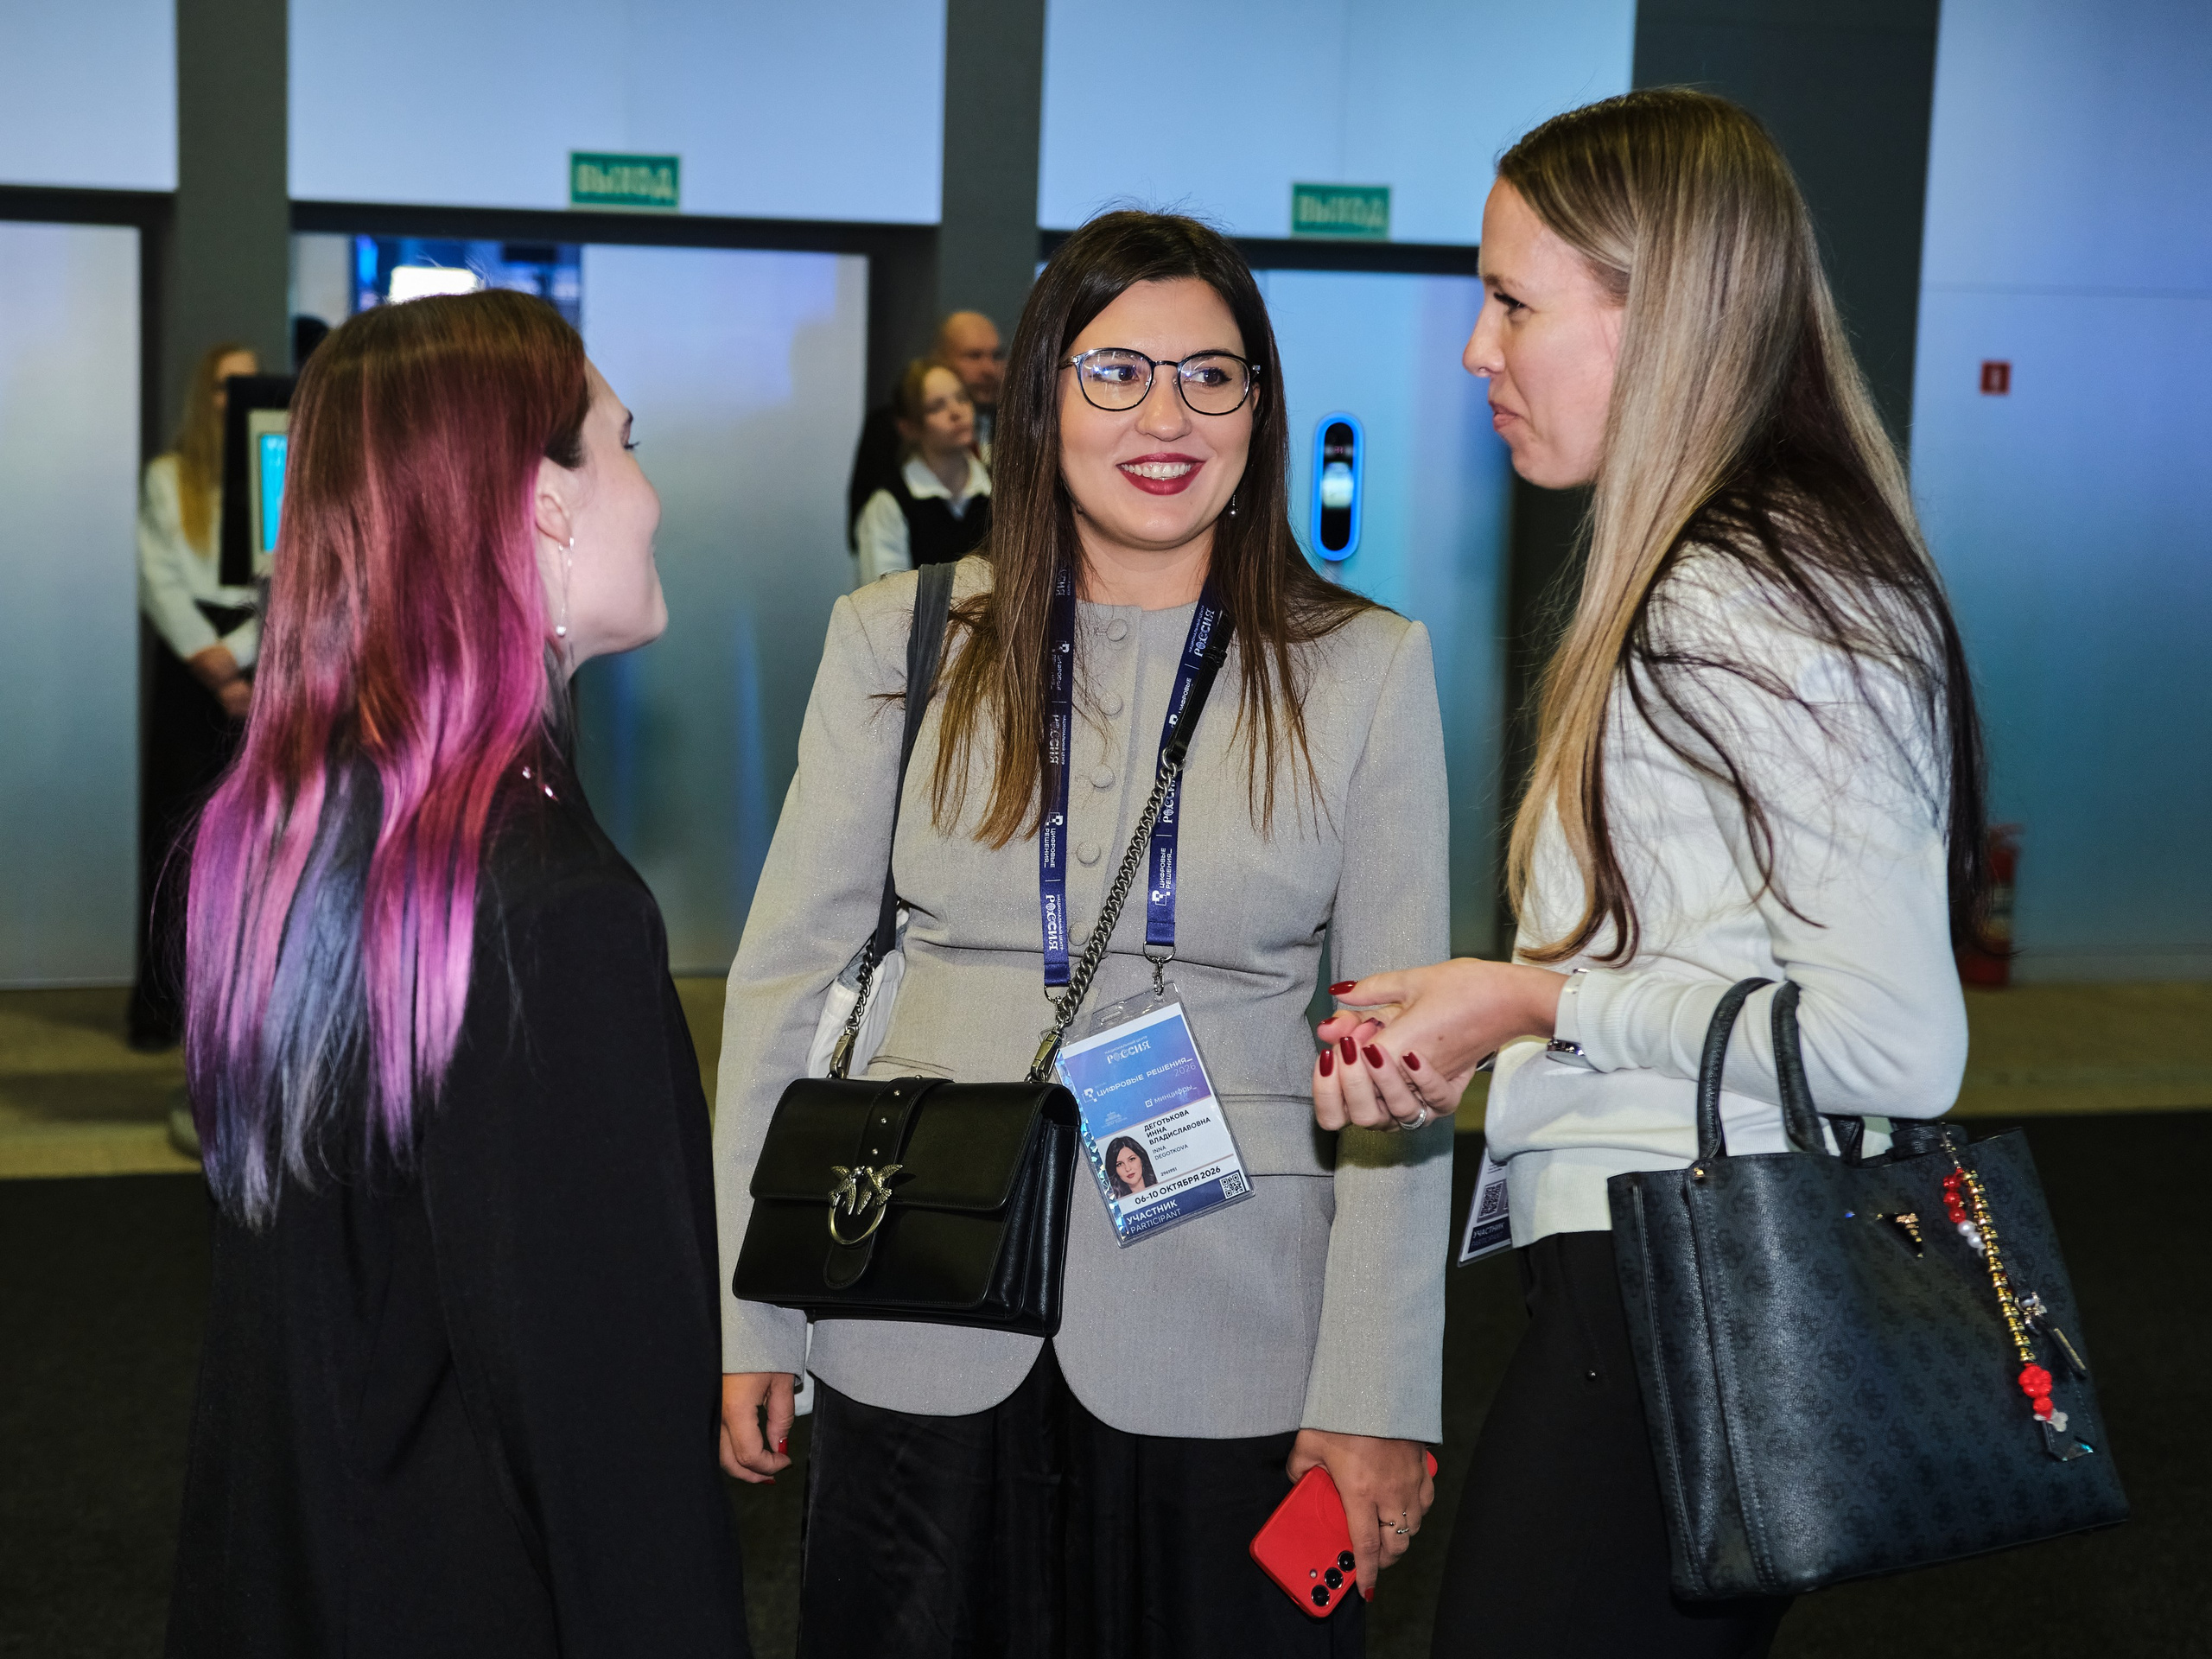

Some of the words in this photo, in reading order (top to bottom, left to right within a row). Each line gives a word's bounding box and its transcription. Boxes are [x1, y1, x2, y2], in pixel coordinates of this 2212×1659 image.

[1194, 607, 1215, 657] РОССИЯ
[1046, 893, 1058, 951] РОССИЯ
[1106, 1040, 1151, 1065] РОССИЯ
[1173, 1063, 1197, 1077] 2026
[1096, 1074, 1144, 1097] ЦИФРОВЫЕ
[1144, 1109, 1190, 1132] ДЕГОТЬКОВА
[1147, 1126, 1167, 1138] ИННА
[1149, 1117, 1211, 1146] ВЛАДИСЛАВОВНА
[1153, 1146, 1166, 1154] INNA
[1154, 1144, 1189, 1160] DEGOTKOVA
[1135, 1191, 1159, 1205] 06-10
[1160, 1174, 1200, 1195] ОКТЯБРЯ
[1201, 1166, 1221, 1179] 2026
[1126, 1199, 1178, 1224] УЧАСТНИК
[1130, 1208, 1182, 1234] PARTICIPANT
